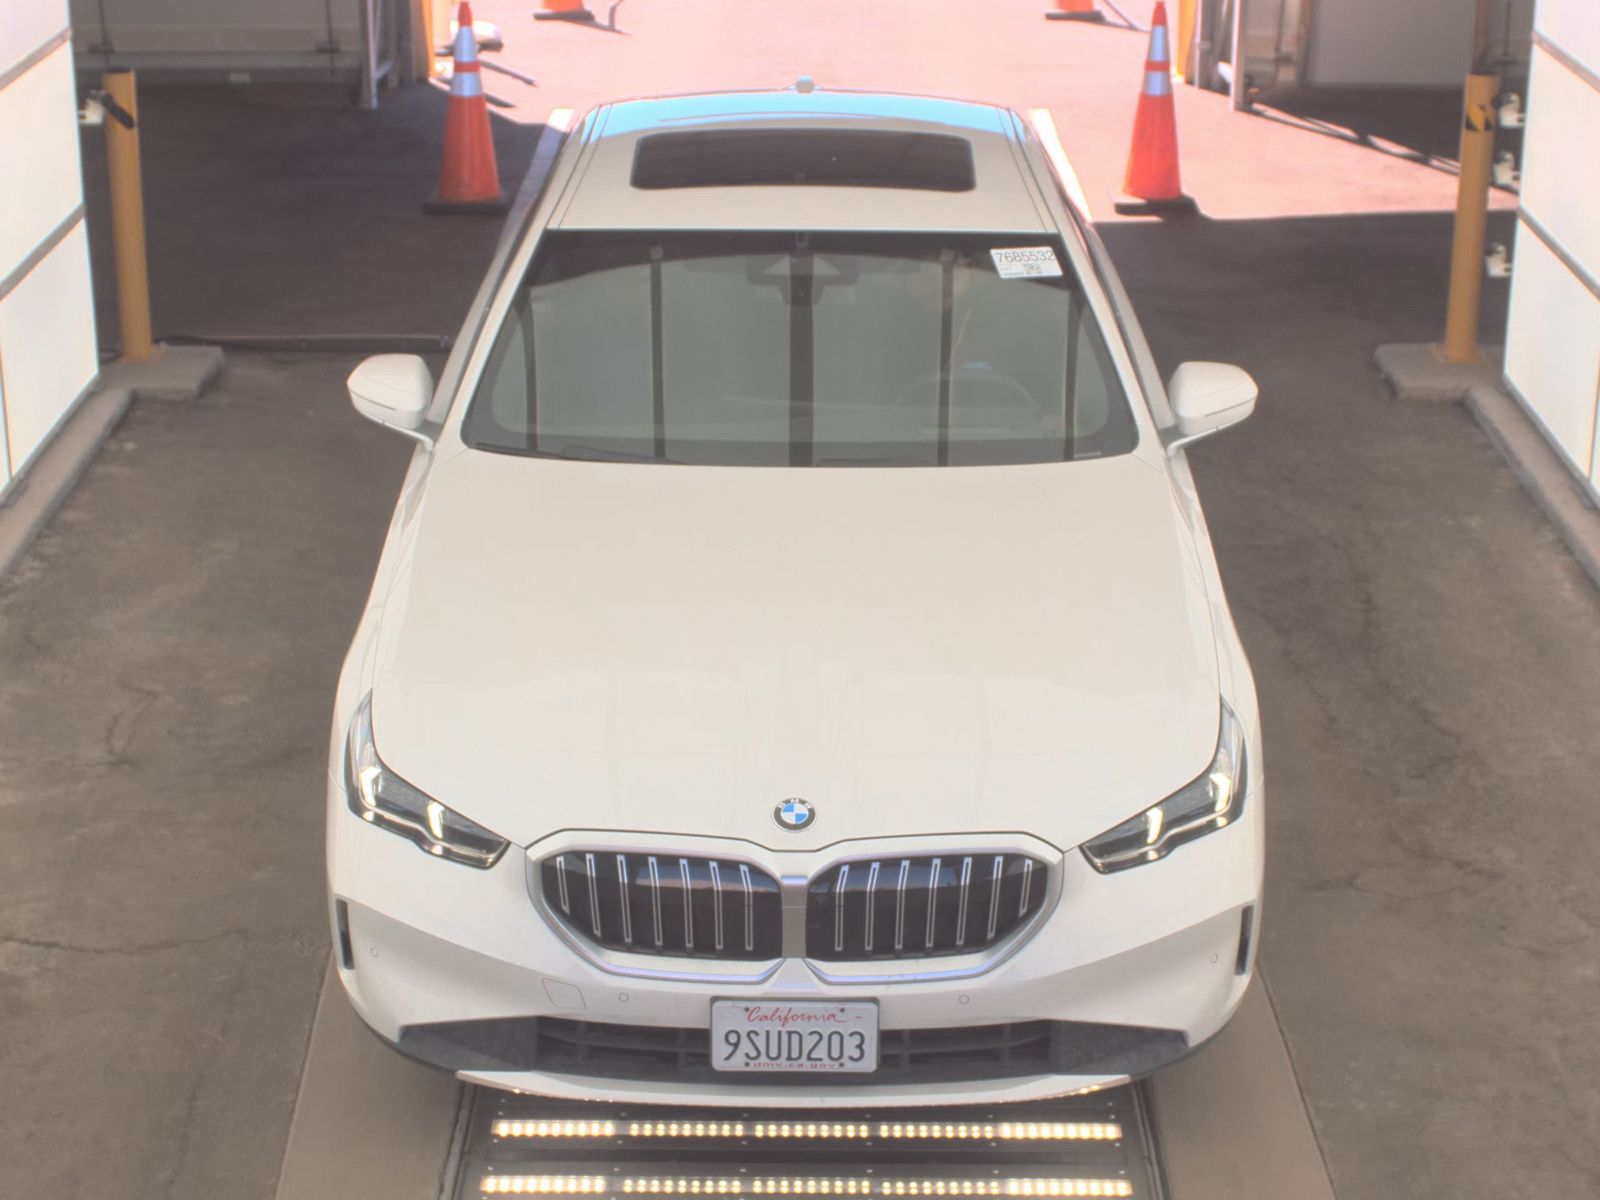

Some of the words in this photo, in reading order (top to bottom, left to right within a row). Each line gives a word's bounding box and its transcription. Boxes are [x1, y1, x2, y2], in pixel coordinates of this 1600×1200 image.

[747, 1006, 847, 1026] California
[723, 1029, 865, 1062] 9SUD203
[753, 1061, 836, 1069] dmv.ca.gov
